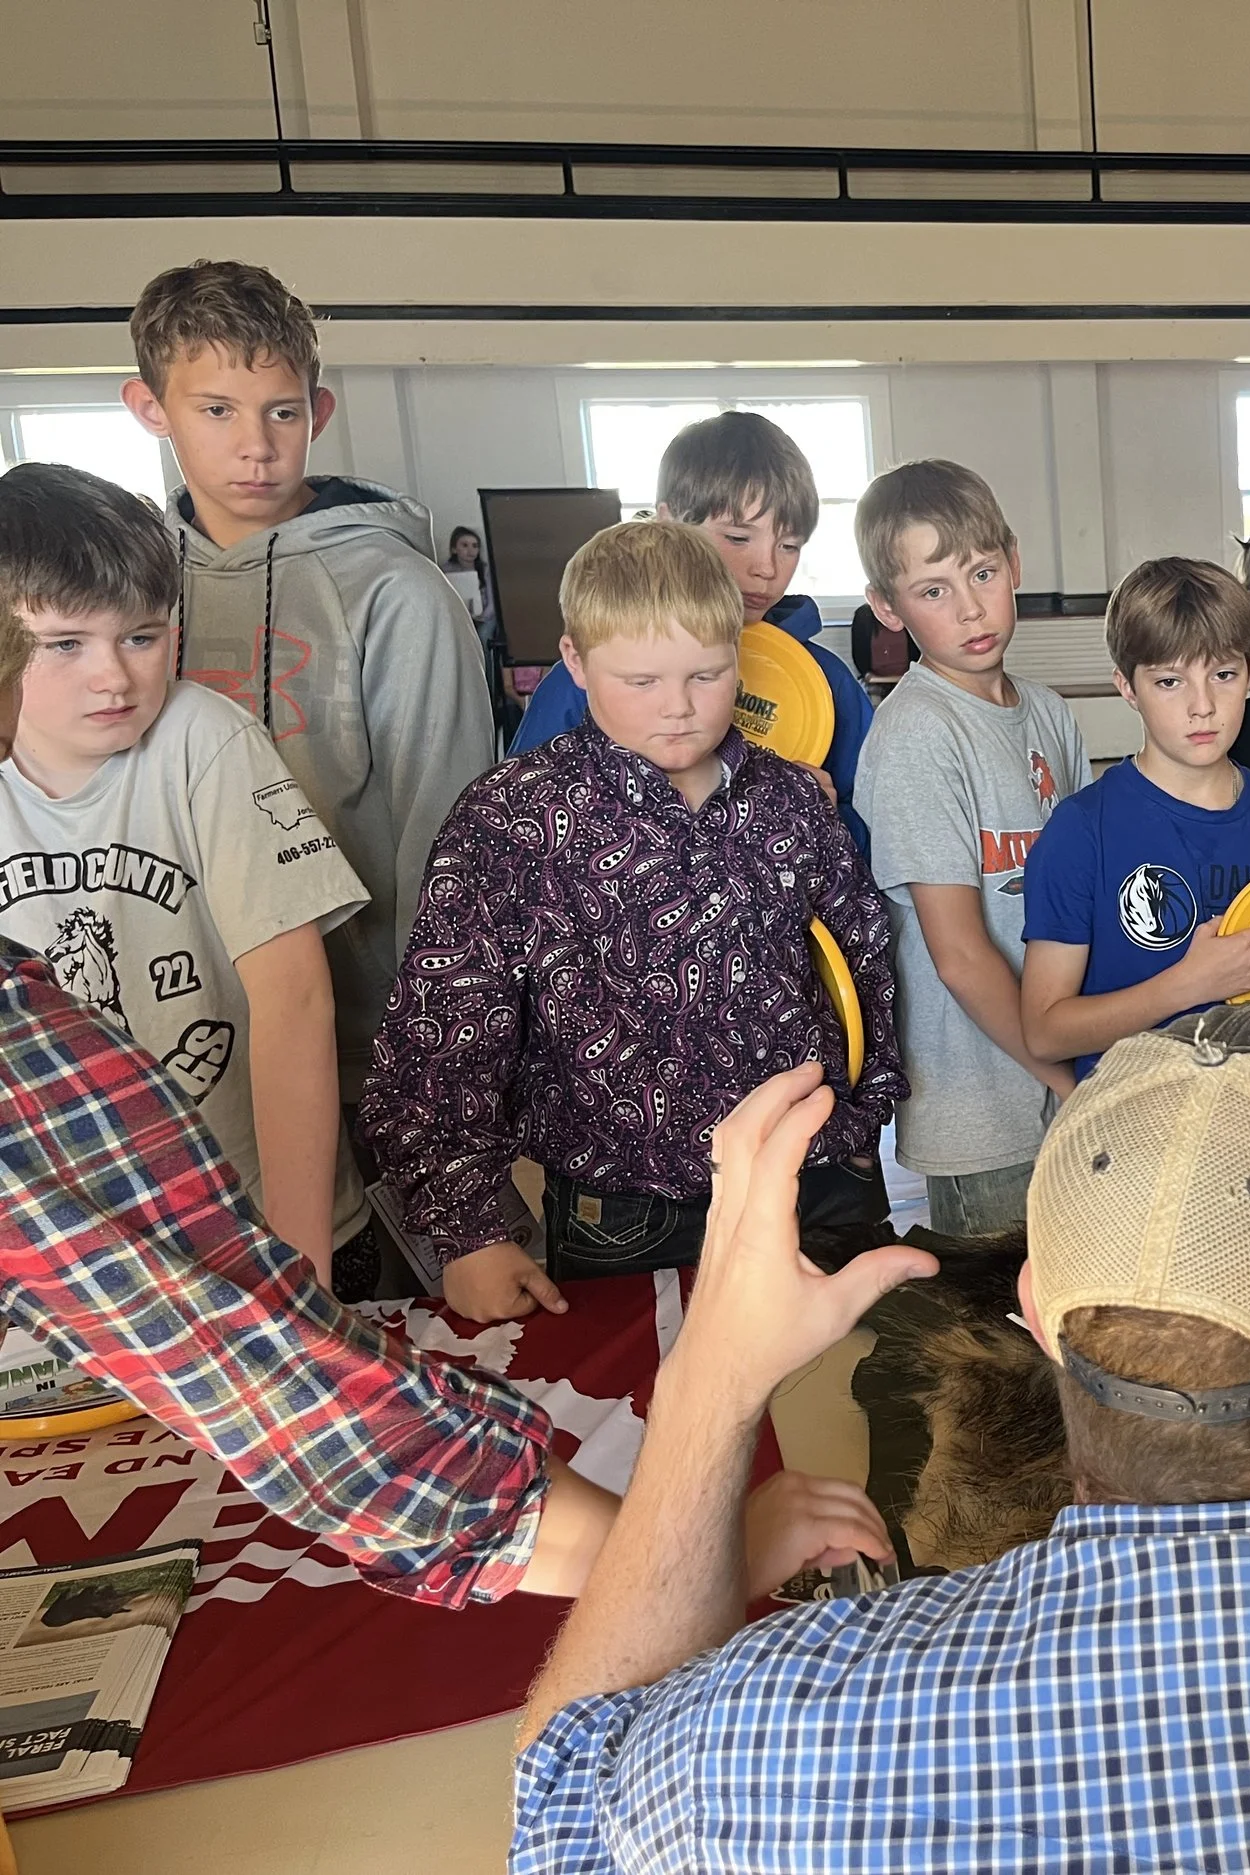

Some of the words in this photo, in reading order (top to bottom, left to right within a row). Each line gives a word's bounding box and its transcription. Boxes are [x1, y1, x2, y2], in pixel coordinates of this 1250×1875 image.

[256, 784, 284, 801] Farmers
[277, 835, 336, 865] 406-557-22
[149, 951, 202, 1002] 22
[20, 1727, 72, 1746] FACT
[7, 1739, 66, 1758] FERAL
